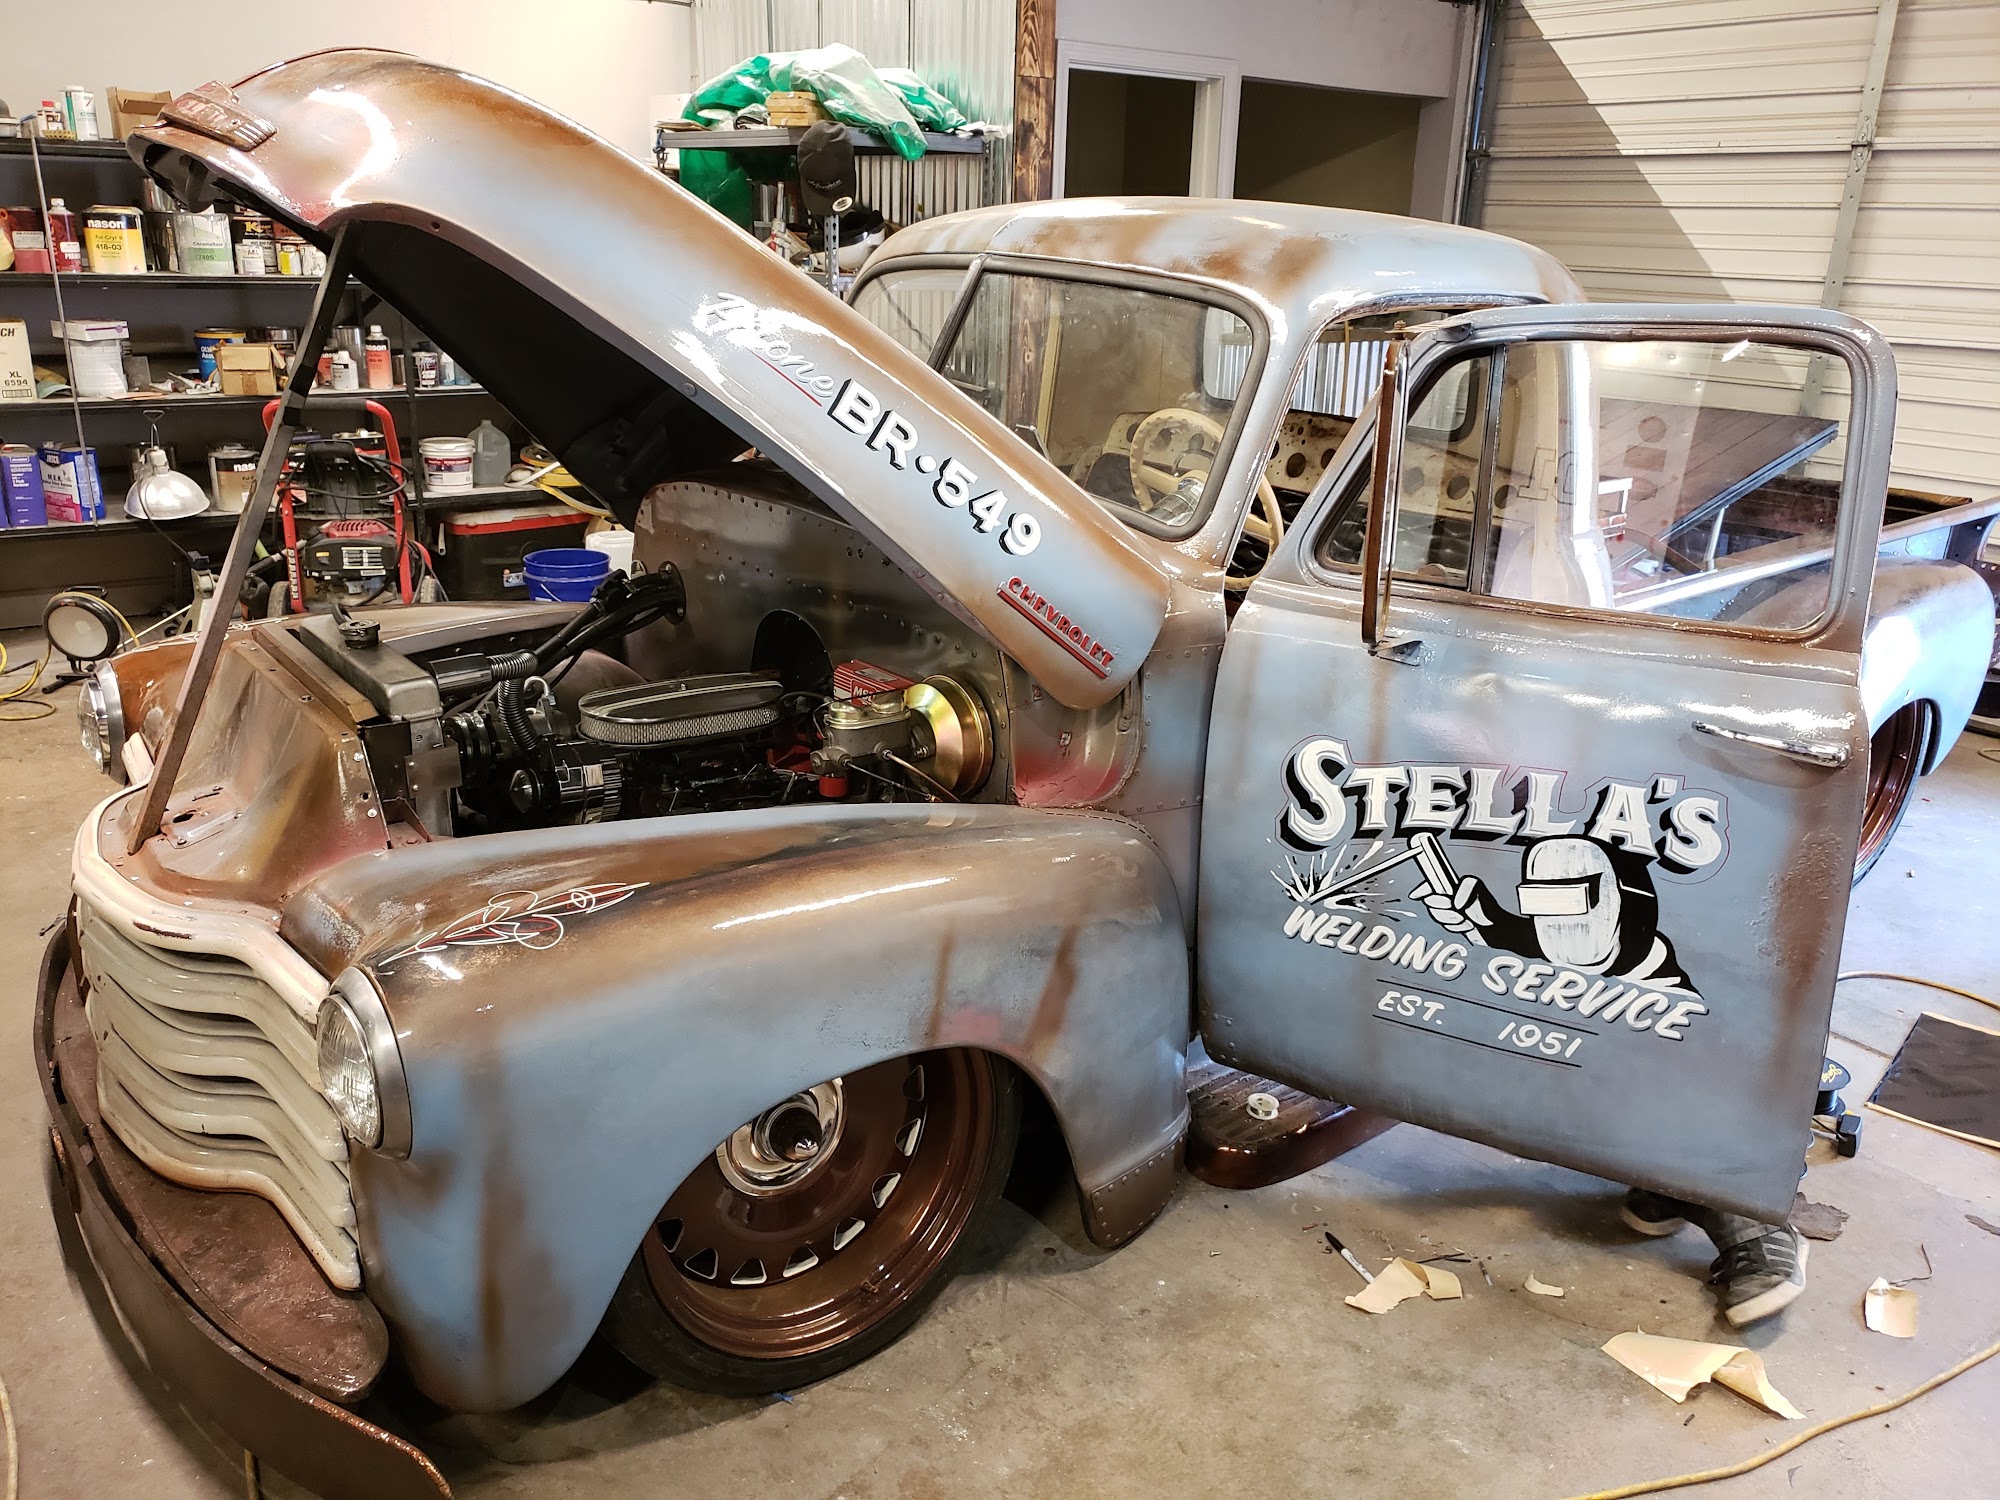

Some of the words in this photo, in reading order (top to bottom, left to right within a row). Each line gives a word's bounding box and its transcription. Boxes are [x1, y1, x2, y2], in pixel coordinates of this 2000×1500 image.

[87, 219, 125, 229] nason
[4, 379, 28, 387] 6594
[9, 370, 22, 378] XL
[1007, 577, 1115, 668] CHEVROLET
[1281, 739, 1723, 874] STELLA'S
[1282, 905, 1468, 981] WELDING
[1481, 955, 1709, 1041] SERVICE
[1376, 990, 1446, 1027] EST.
[1497, 1021, 1583, 1059] 1951
